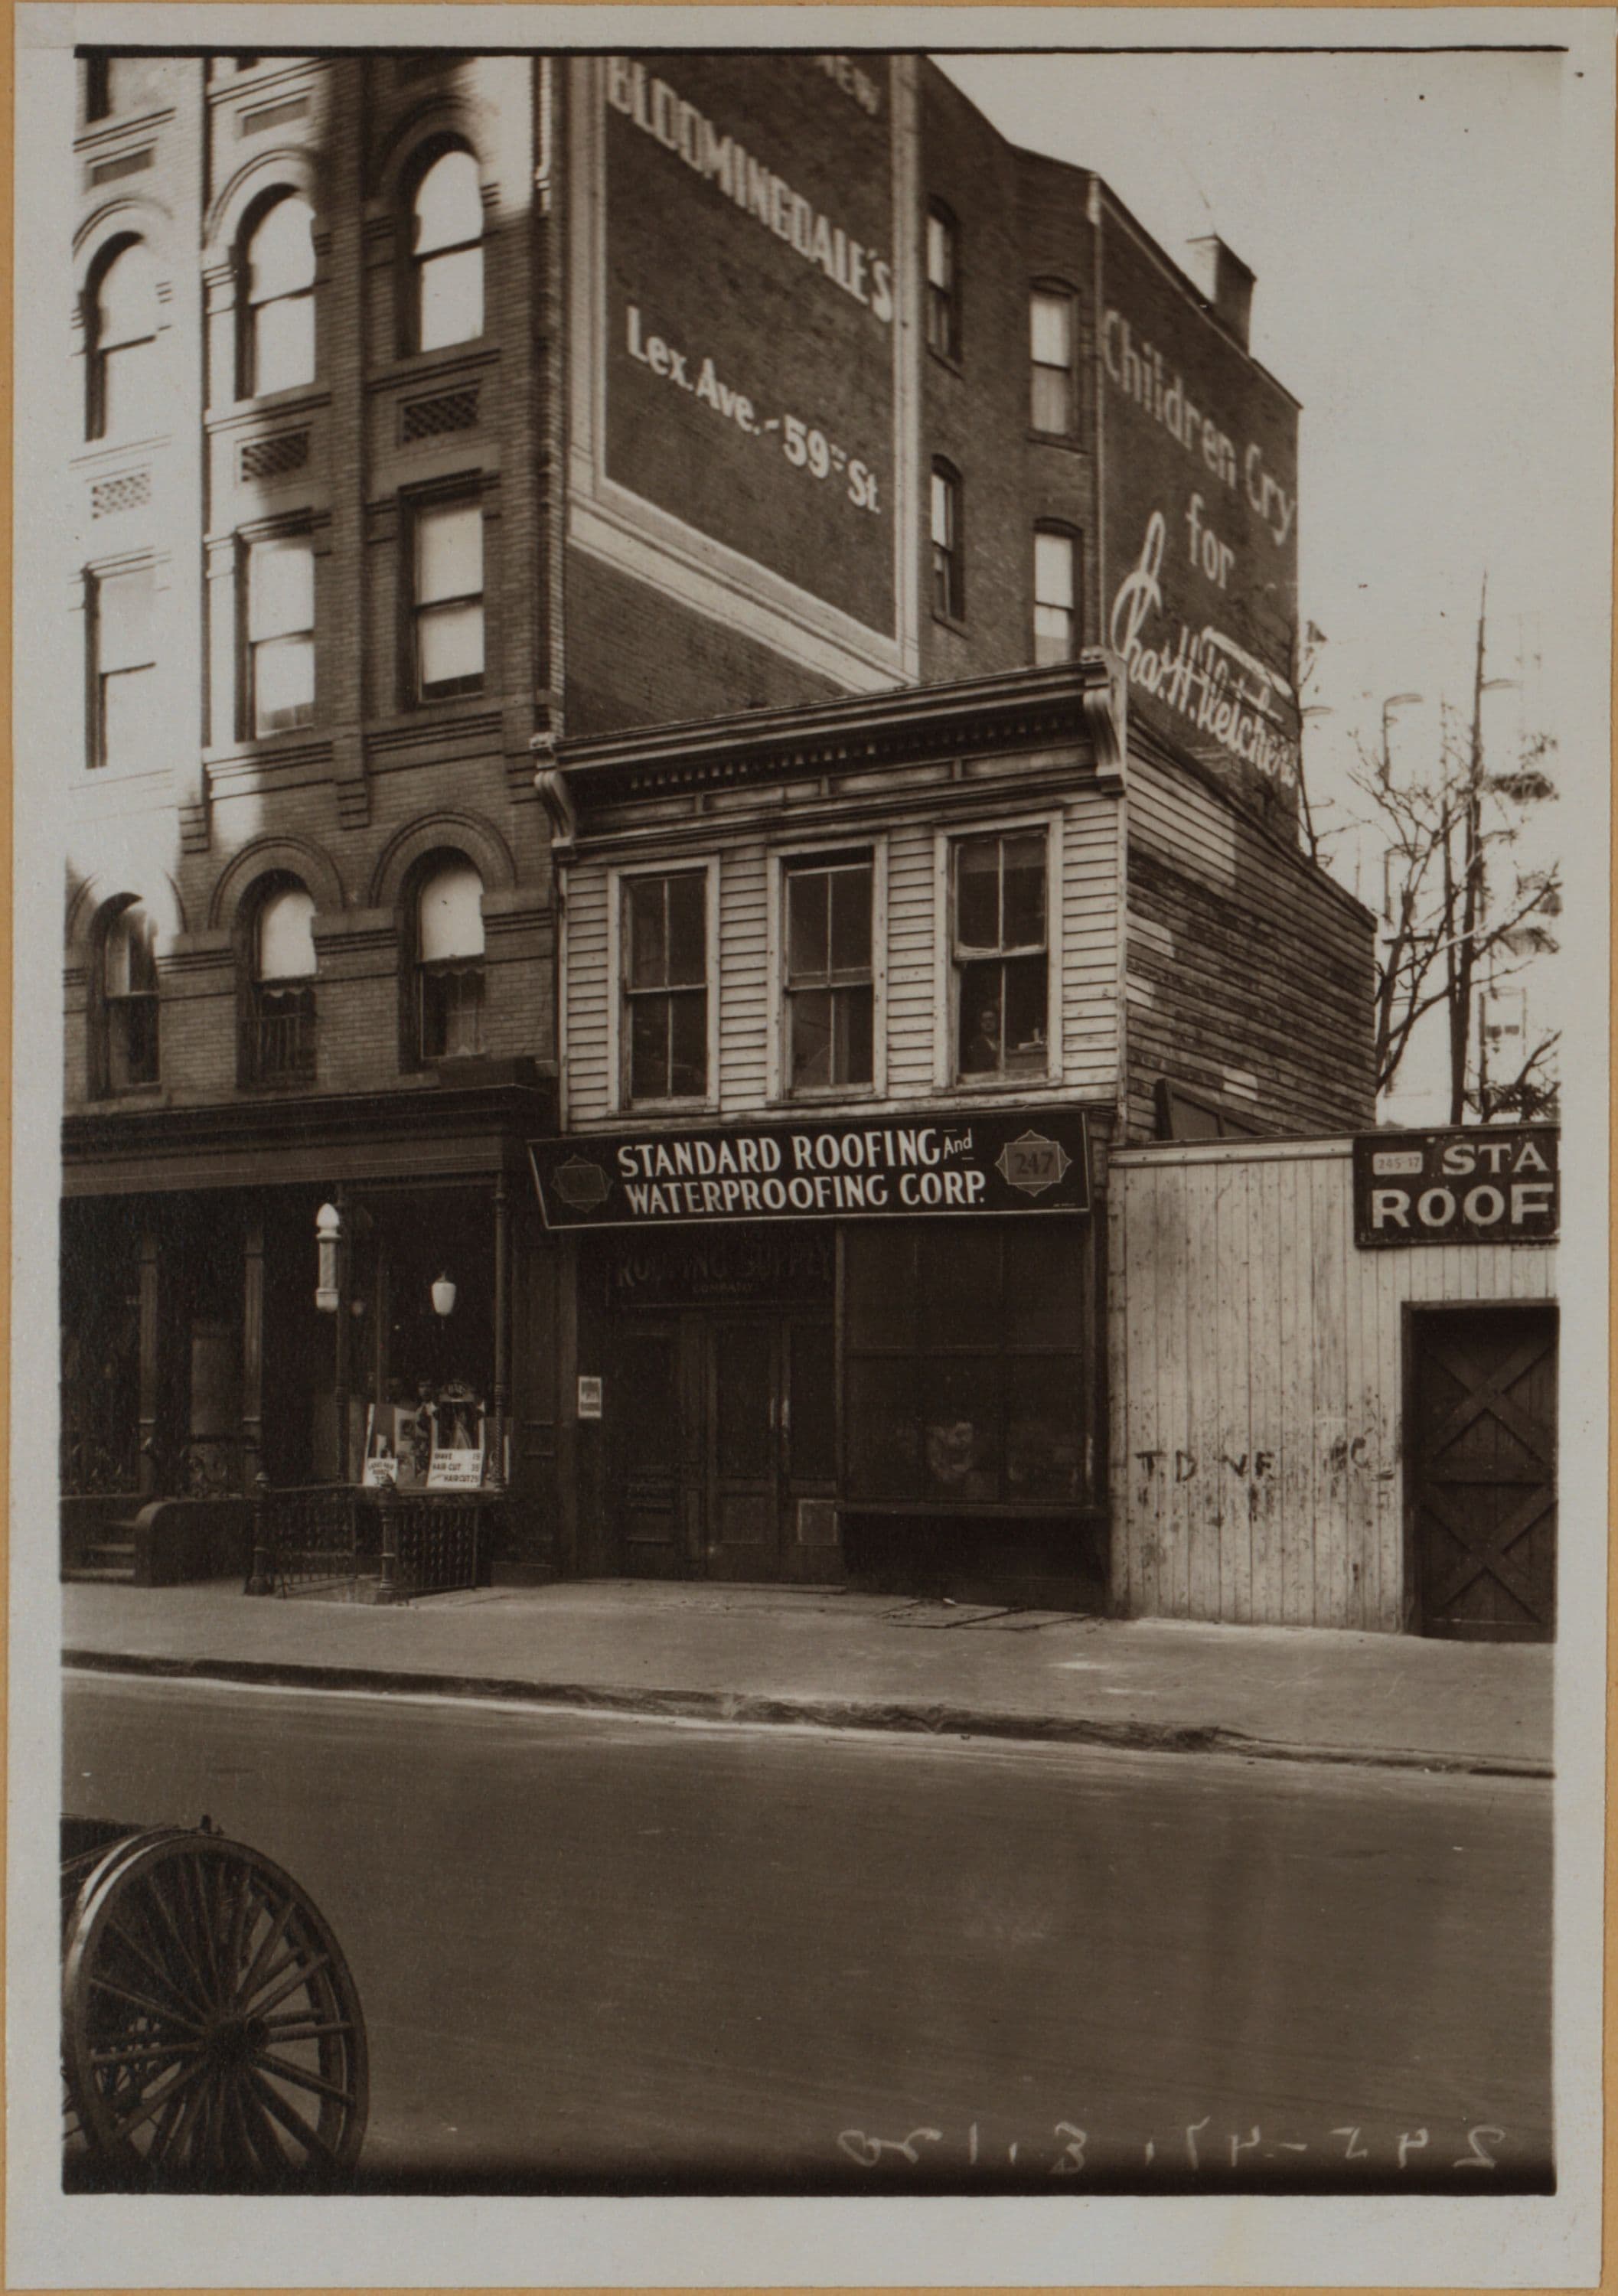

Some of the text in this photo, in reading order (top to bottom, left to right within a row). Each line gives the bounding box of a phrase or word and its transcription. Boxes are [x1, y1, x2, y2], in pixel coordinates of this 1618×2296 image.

[1103, 309, 1297, 546] Children Cry
[1185, 491, 1236, 591] for
[617, 1128, 973, 1179] STANDARD ROOFING And
[1014, 1151, 1055, 1176] 247
[1442, 1141, 1550, 1176] STA
[624, 1170, 986, 1215] WATERPROOFING CORP.
[1372, 1182, 1554, 1228] ROOF
